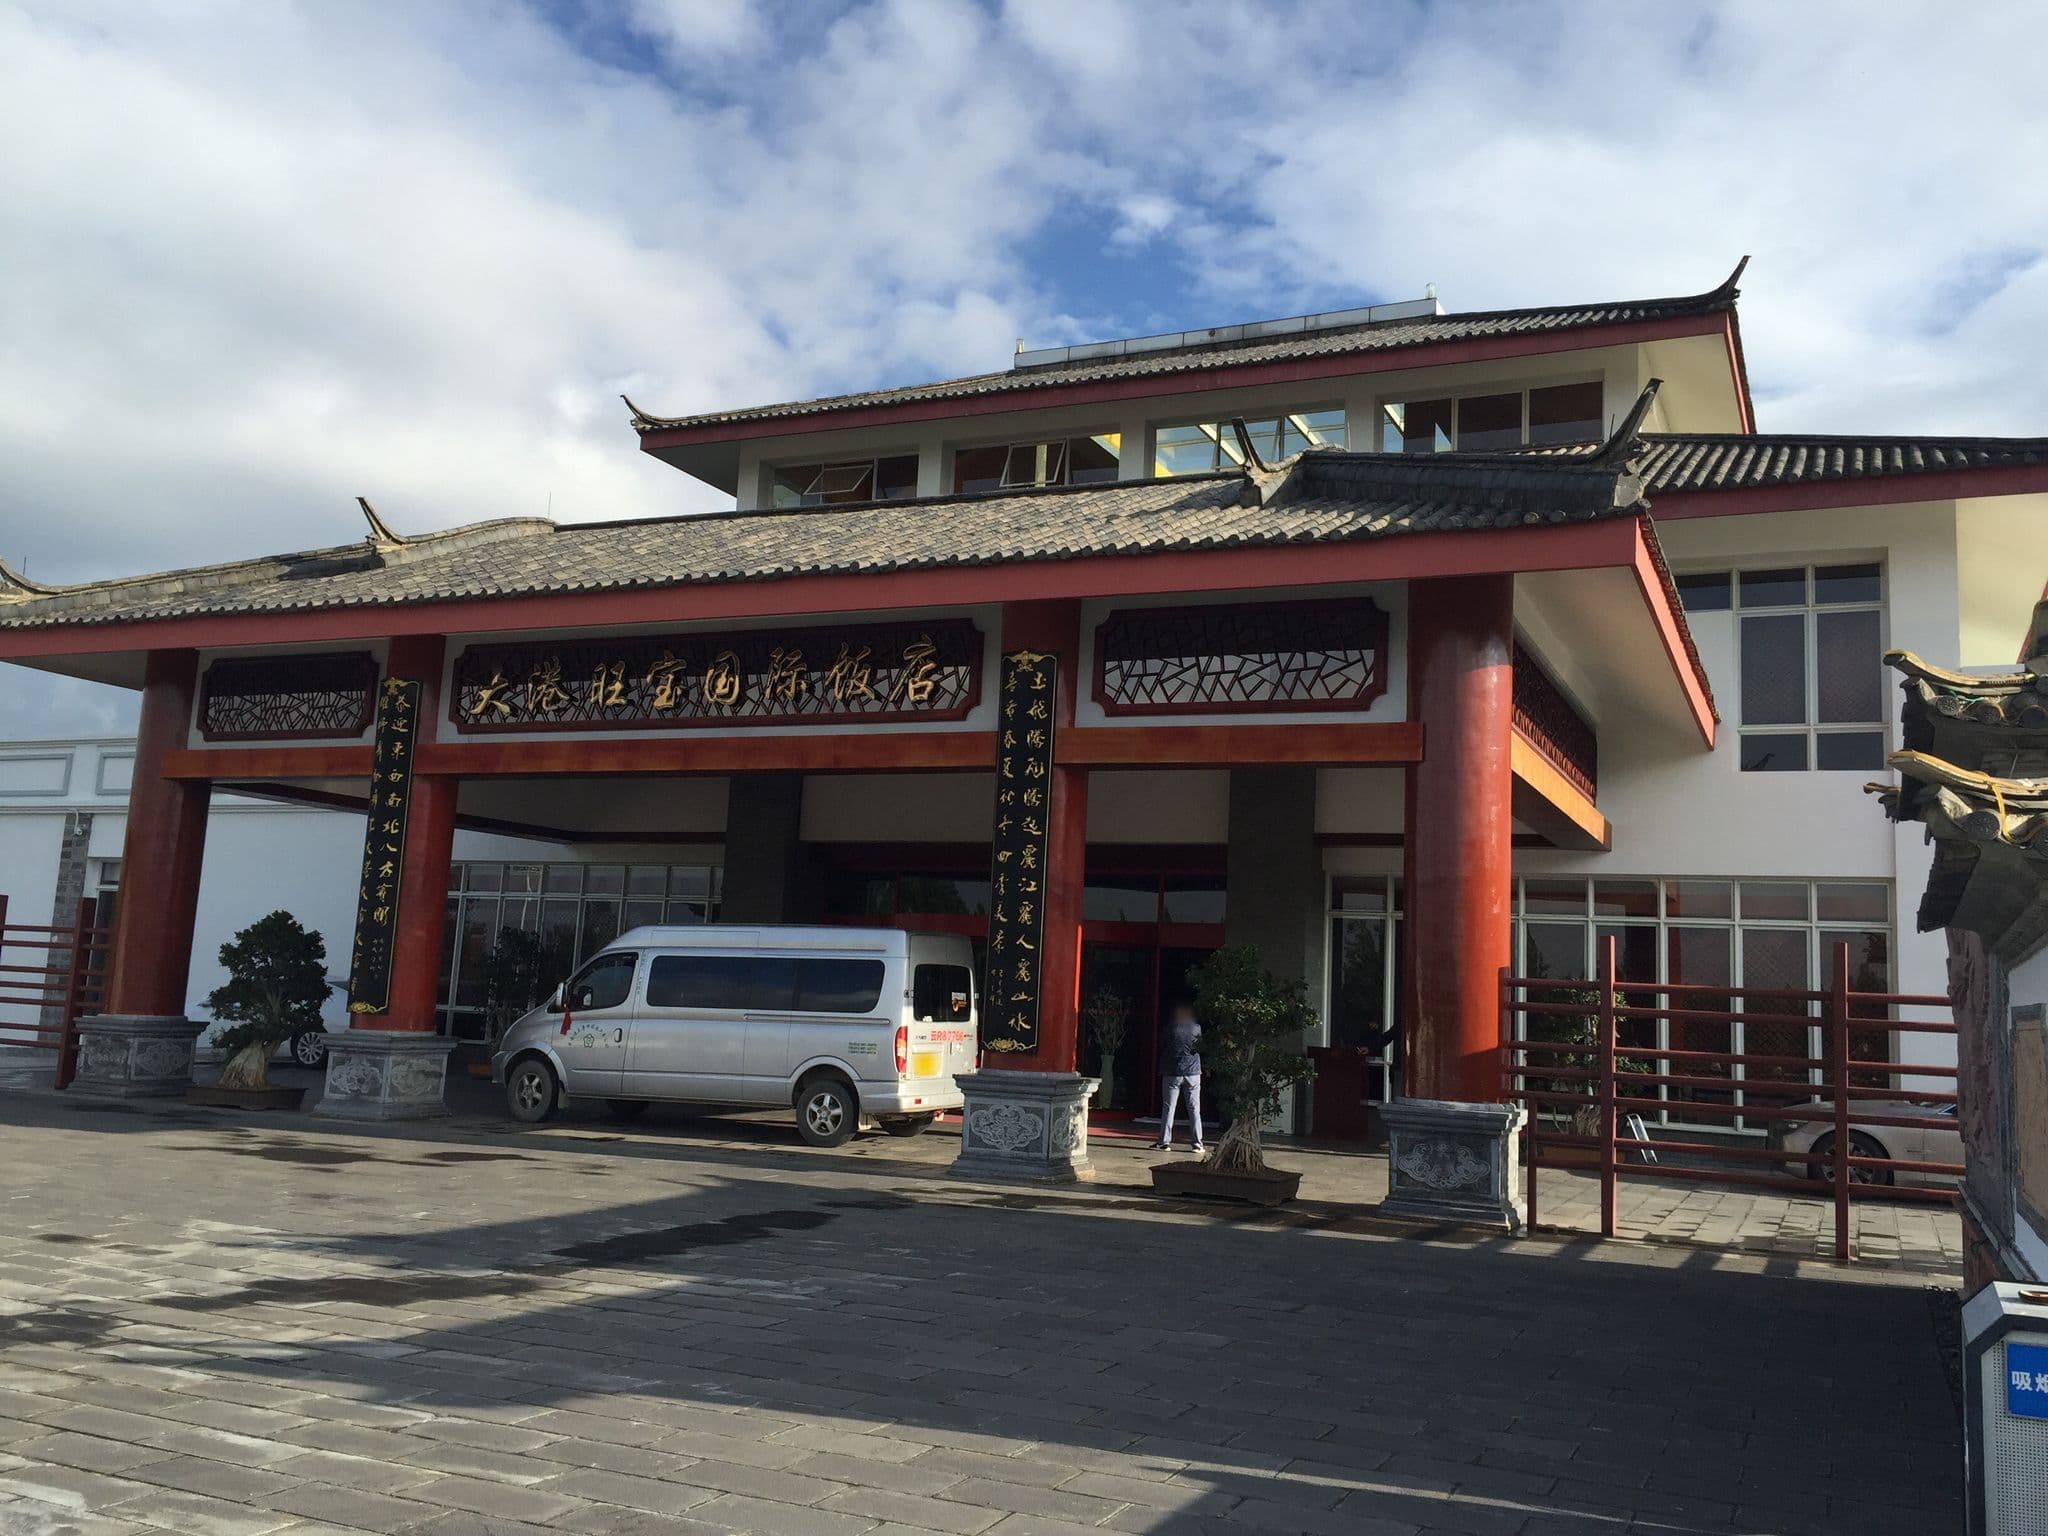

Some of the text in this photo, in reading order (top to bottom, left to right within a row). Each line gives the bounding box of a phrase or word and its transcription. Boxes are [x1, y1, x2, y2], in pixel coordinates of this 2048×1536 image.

[470, 634, 938, 717] 大港旺宝国际饭店
